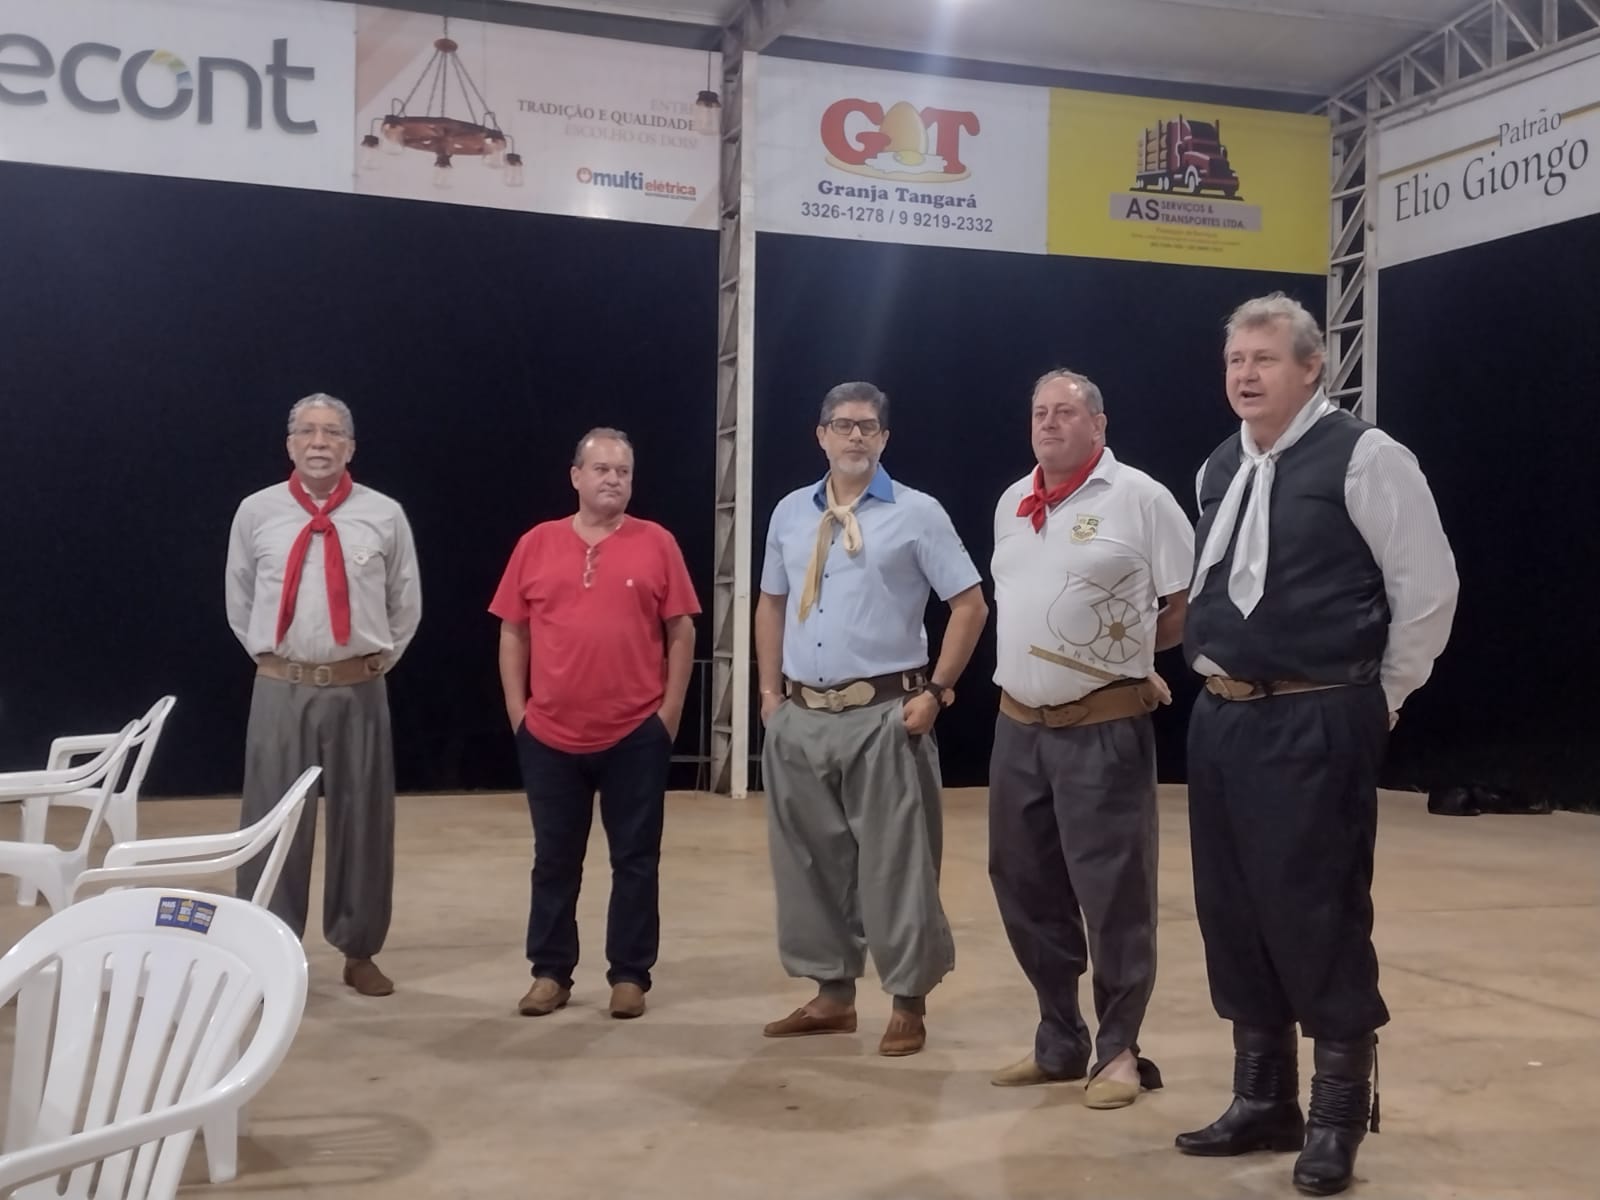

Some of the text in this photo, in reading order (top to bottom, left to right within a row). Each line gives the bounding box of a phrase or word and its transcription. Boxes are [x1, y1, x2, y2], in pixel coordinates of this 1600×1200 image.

[517, 99, 697, 131] TRADIÇÃO E QUALIDADE
[1499, 108, 1562, 147] Patrão
[592, 171, 643, 190] multi
[818, 180, 977, 209] Granja Tangará
[1394, 139, 1589, 222] Elio Giongo
[801, 202, 884, 223] 3326-1278
[899, 211, 908, 225] 9
[913, 213, 993, 233] 9219-2332
[1126, 198, 1160, 221] AS
[1161, 201, 1205, 214] SERVIÇOS
[1161, 213, 1220, 227] TRANSPORTES
